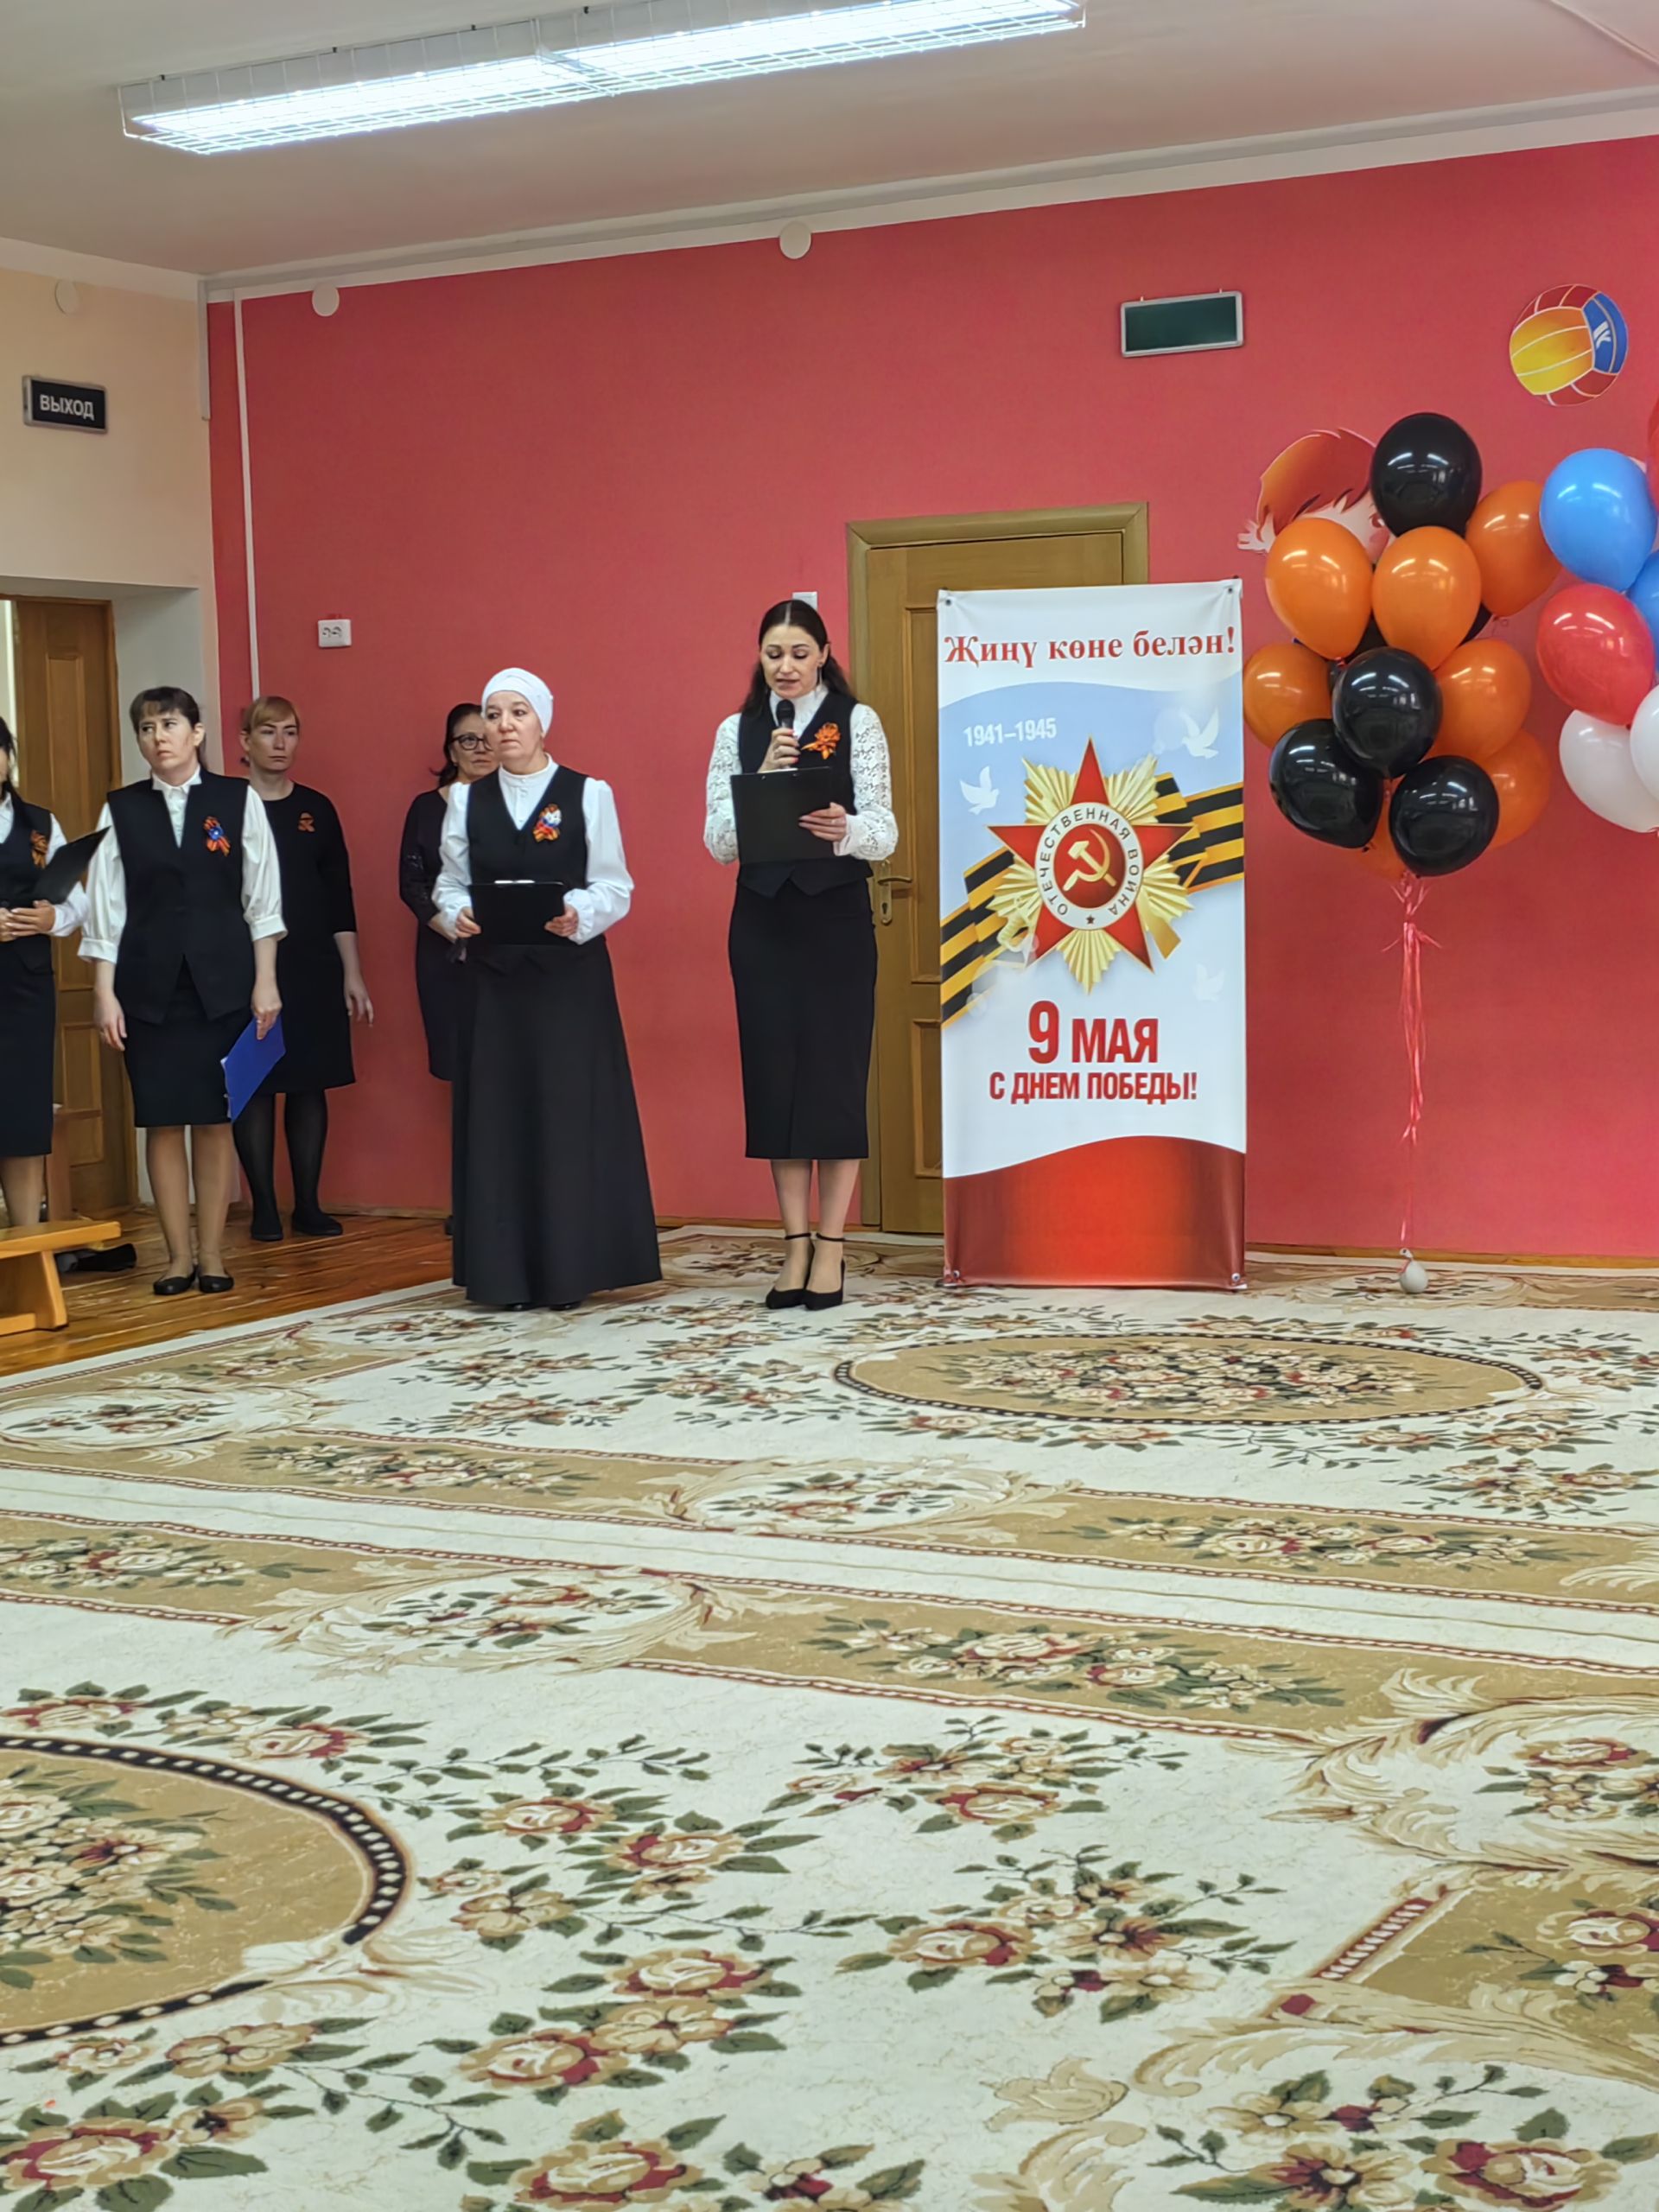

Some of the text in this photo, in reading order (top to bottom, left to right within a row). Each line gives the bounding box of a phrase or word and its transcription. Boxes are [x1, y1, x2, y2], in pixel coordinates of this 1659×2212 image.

[40, 394, 95, 421] ВЫХОД
[944, 626, 1235, 668] Җиңү көне белән!
[1039, 807, 1131, 916] ОТЕЧЕСТВЕННАЯ
[1028, 1001, 1159, 1065] 9 МАЯ
[989, 1071, 1198, 1105] С ДНЕМ ПОБЕДЫ!
